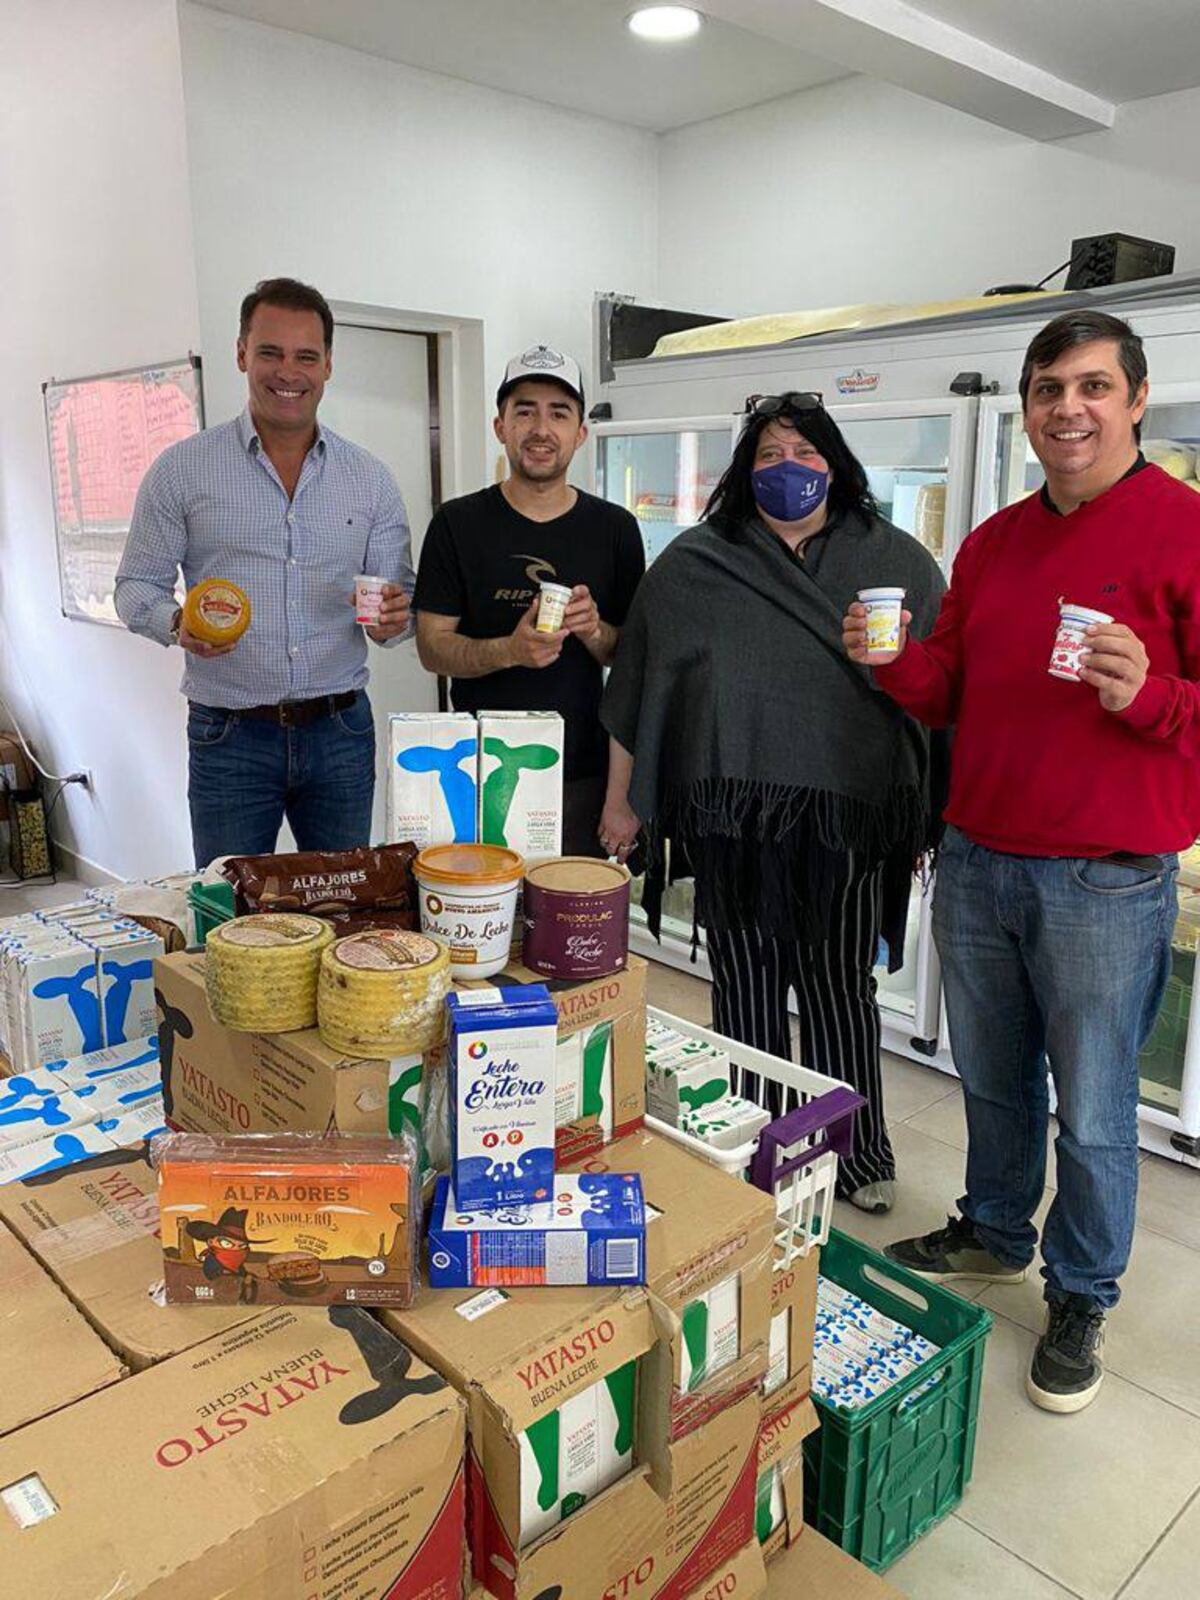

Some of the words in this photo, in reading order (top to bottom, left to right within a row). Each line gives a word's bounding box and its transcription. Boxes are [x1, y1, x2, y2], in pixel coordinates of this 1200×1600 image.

[494, 588, 534, 600] RIP
[293, 870, 367, 889] ALFAJORES
[422, 914, 451, 937] Dulce
[454, 923, 477, 940] De
[480, 920, 509, 940] Leche
[558, 981, 621, 1016] ATASTO
[482, 1058, 521, 1078] Leche
[178, 1055, 251, 1129] YATASTO
[464, 1075, 547, 1112] Entera
[223, 1186, 350, 1202] ALFAJORES
[255, 1211, 333, 1228] BANDOLERO
[260, 1348, 324, 1383] BUENA
[515, 1319, 616, 1391] YATASTO
[196, 1381, 259, 1418] LECHE
[530, 1378, 567, 1408] BUENA
[567, 1358, 600, 1385] LECHE
[156, 1359, 351, 1468] YATASTO
